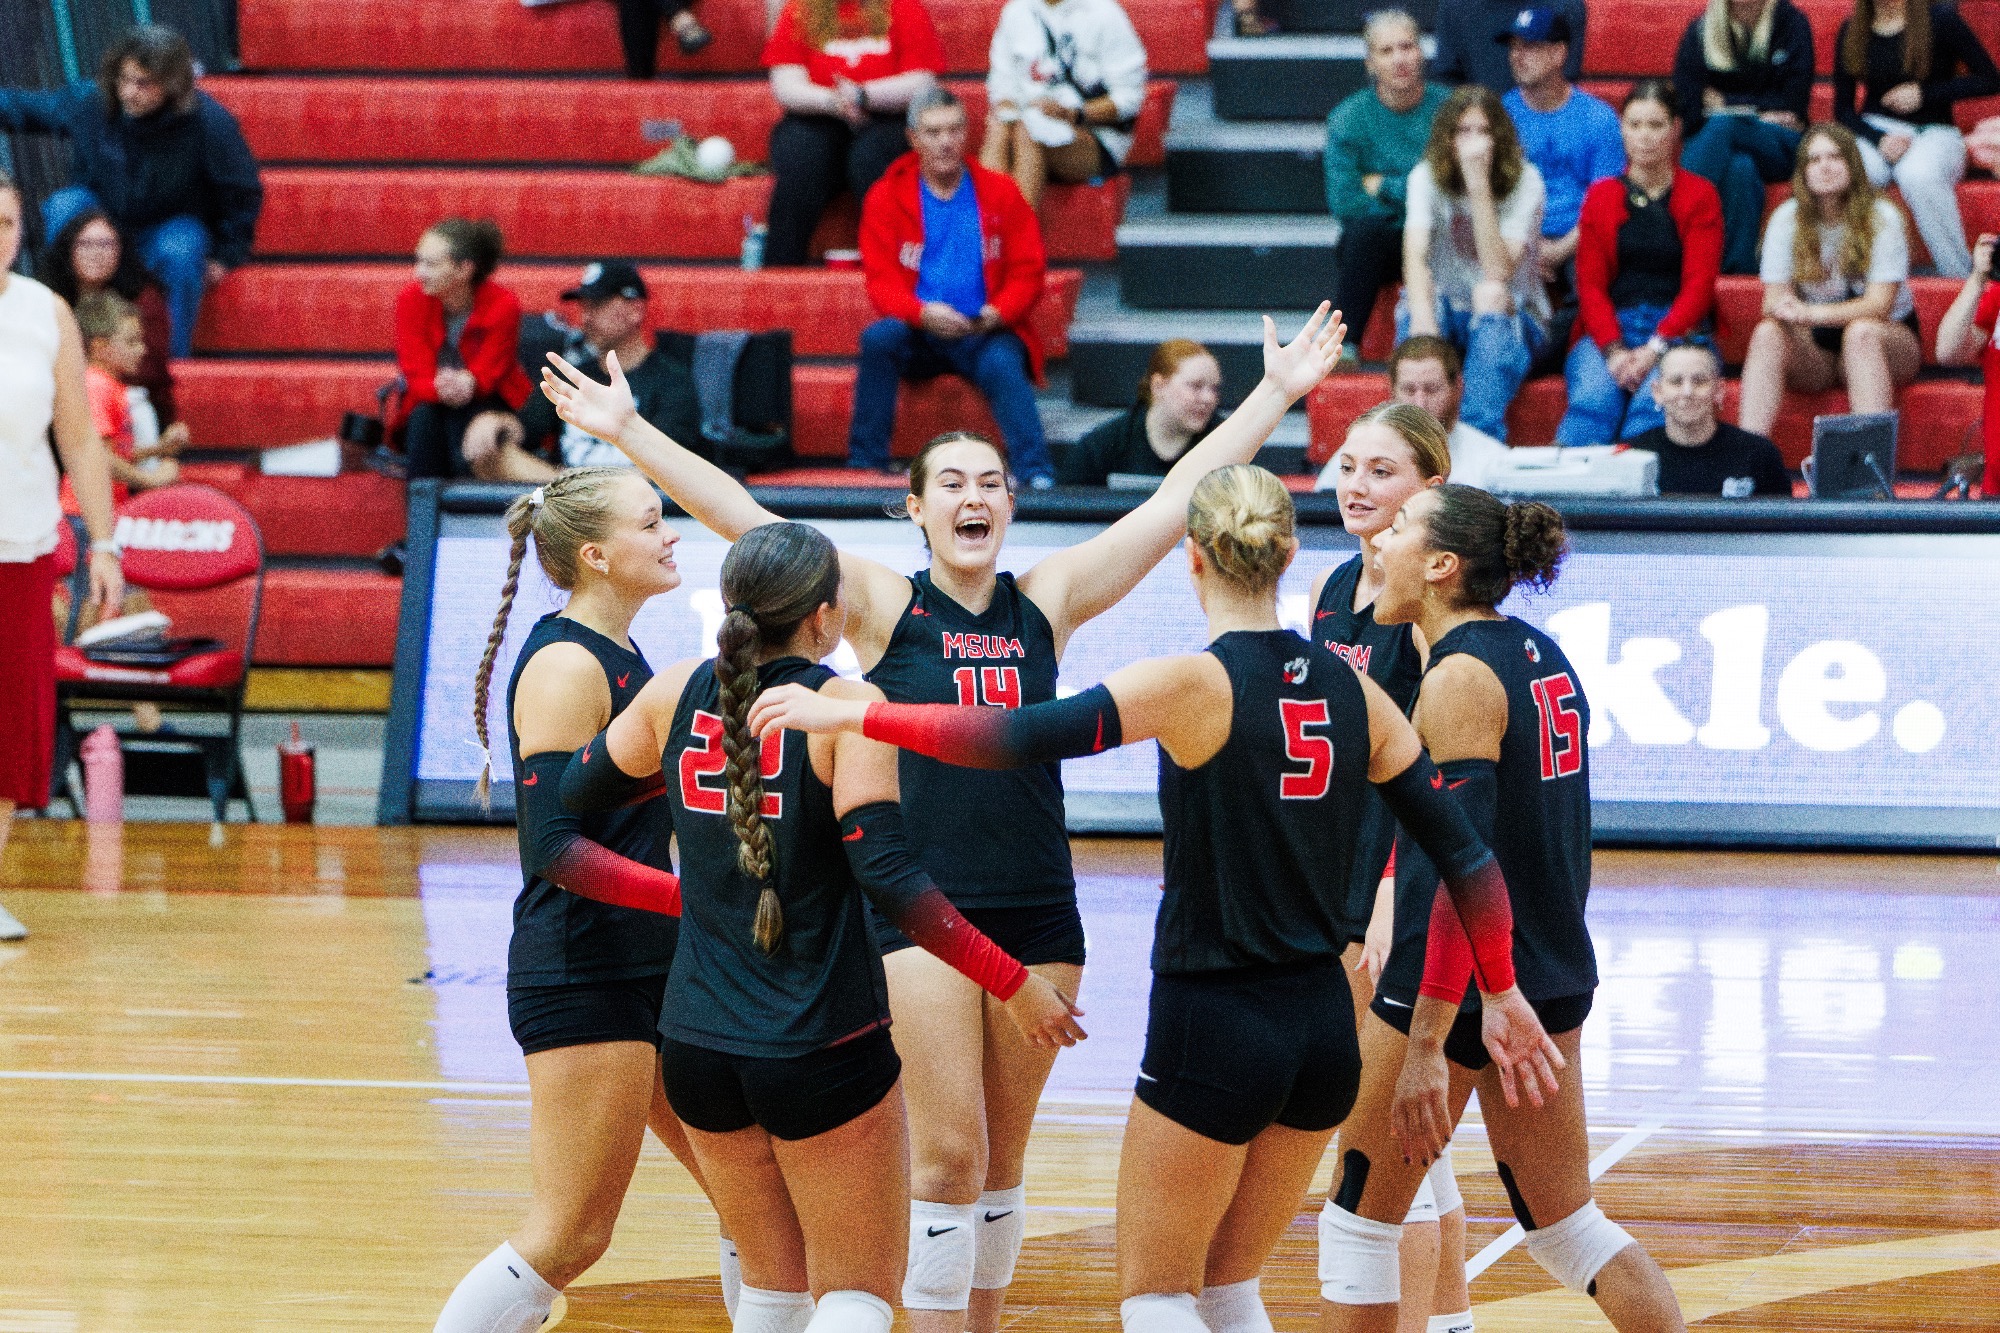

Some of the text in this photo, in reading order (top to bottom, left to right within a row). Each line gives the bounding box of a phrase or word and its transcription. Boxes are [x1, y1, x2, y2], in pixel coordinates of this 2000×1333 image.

[942, 632, 1025, 658] MSUM
[953, 667, 1021, 709] 14
[1546, 601, 1946, 753] kle.
[1279, 699, 1334, 800] 5
[1530, 672, 1582, 780] 15
